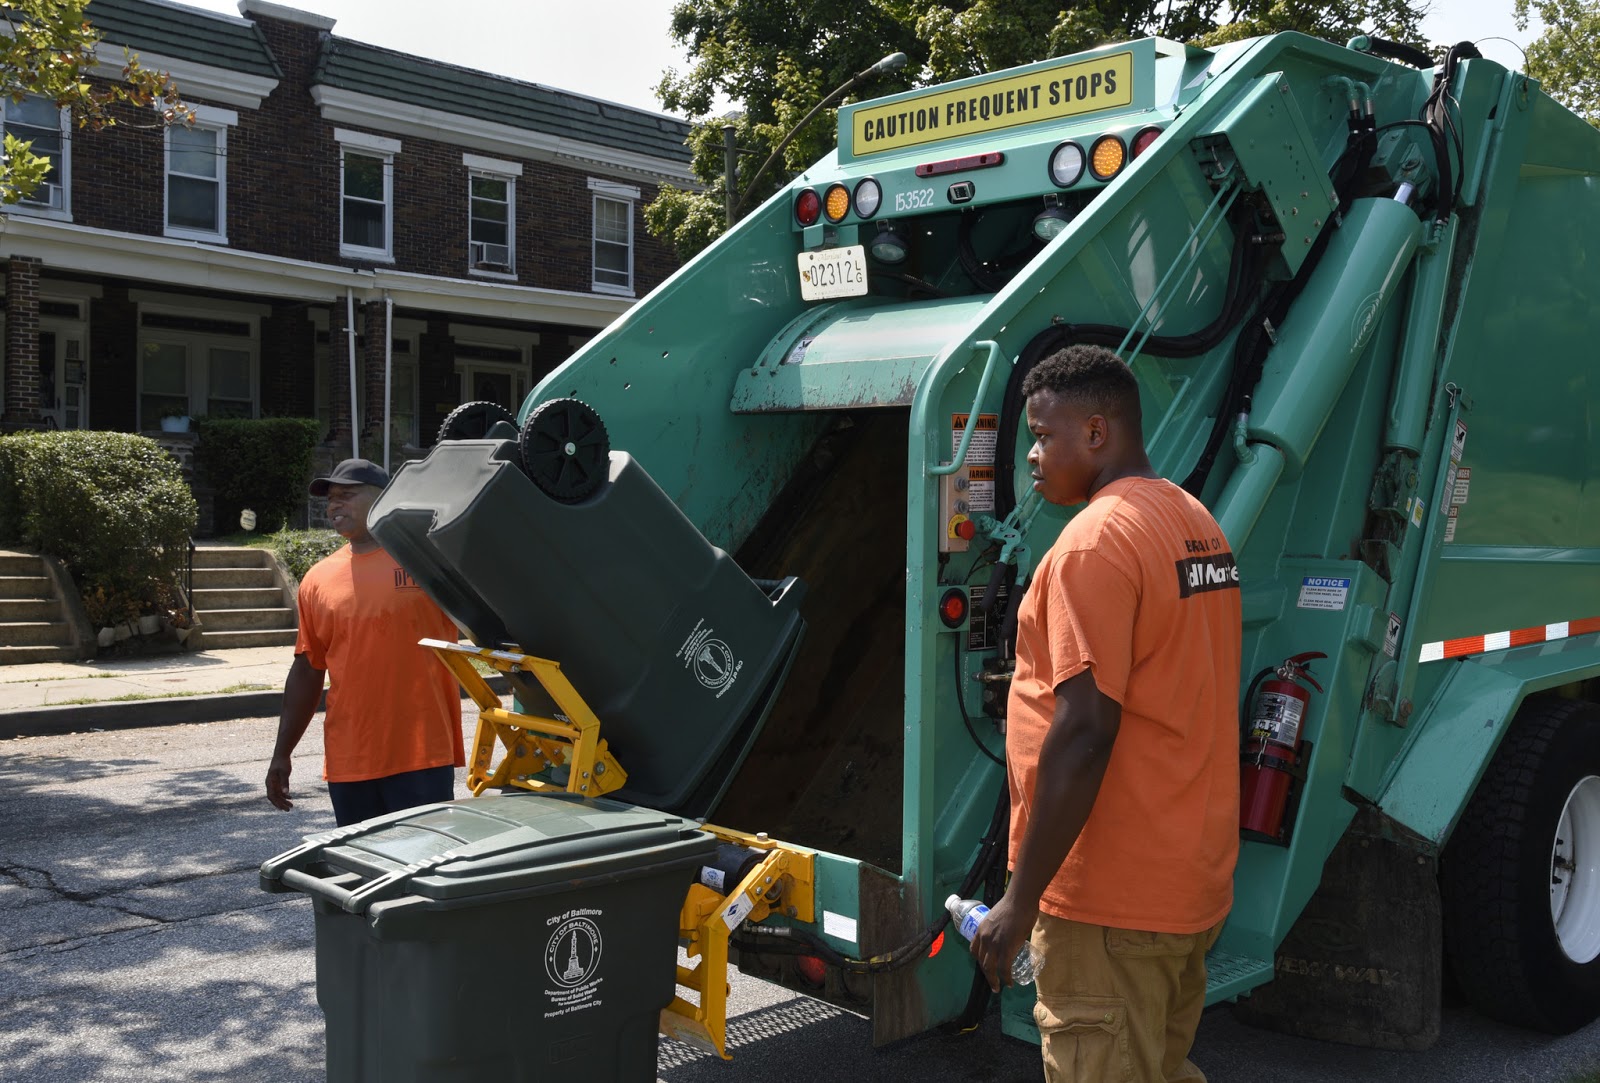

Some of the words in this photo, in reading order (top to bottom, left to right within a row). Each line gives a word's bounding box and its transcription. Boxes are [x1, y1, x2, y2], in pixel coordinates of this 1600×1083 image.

[864, 106, 939, 142] CAUTION
[946, 85, 1041, 126] FREQUENT
[1049, 69, 1117, 105] STOPS
[895, 187, 935, 212] 153522
[810, 260, 854, 287] 02312
[394, 567, 416, 587] DP
[1308, 578, 1345, 587] NOTICE
[546, 915, 561, 926] City
[562, 911, 570, 920] of
[571, 908, 603, 917] Baltimore
[550, 935, 559, 953] CITY
[559, 925, 568, 936] OF
[569, 921, 599, 945] BALTIMORE
[544, 1009, 565, 1018] Property
[571, 1002, 593, 1012] Baltimore
